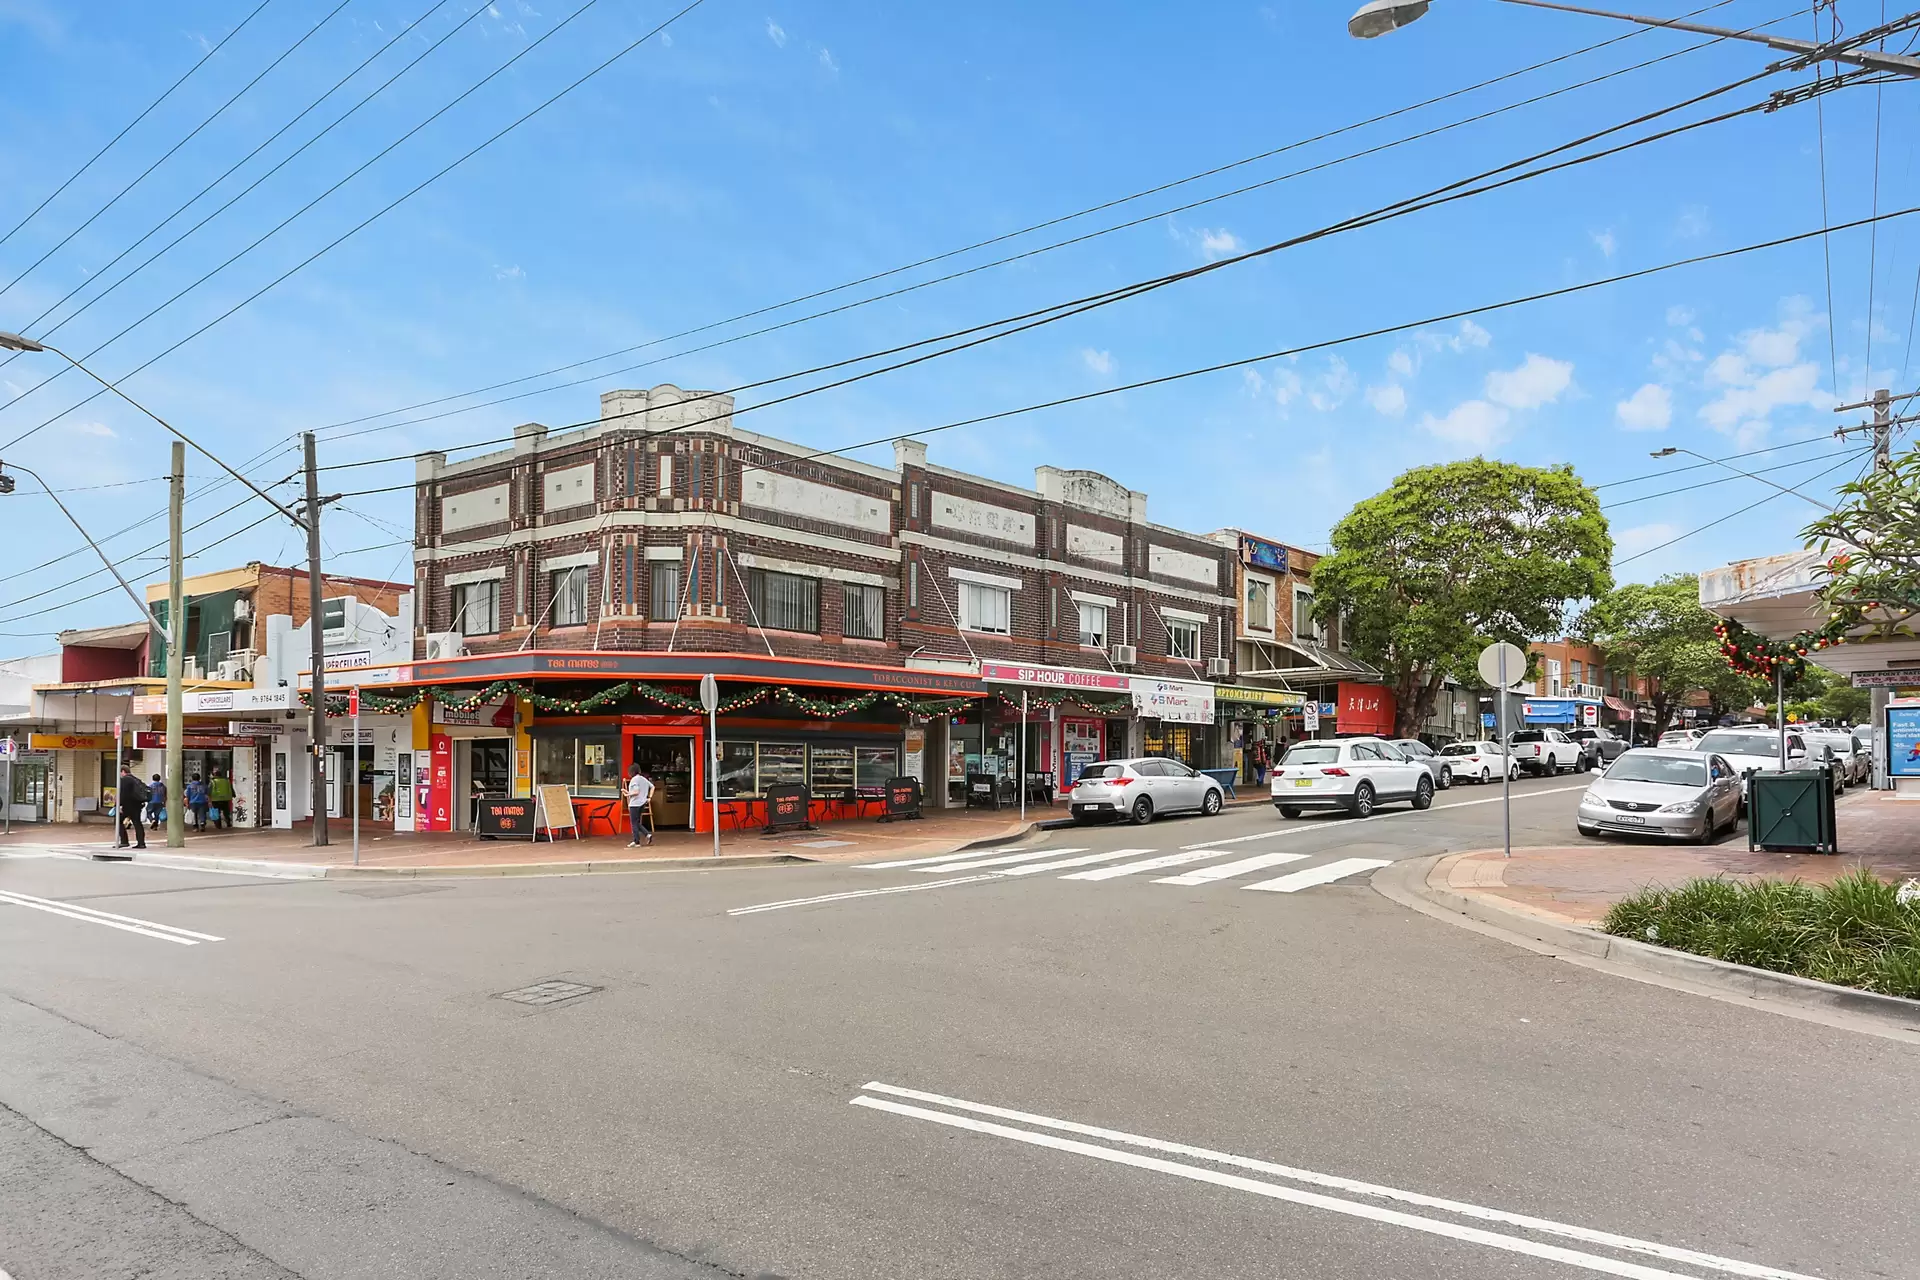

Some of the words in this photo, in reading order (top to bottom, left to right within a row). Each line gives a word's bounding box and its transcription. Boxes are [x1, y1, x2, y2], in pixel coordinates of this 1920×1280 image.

[872, 674, 932, 686] TOBACCONIST
[943, 680, 958, 688] KEY
[960, 680, 977, 689] CUT
[1018, 669, 1034, 681] SIP
[1036, 670, 1064, 684] HOUR
[1068, 673, 1101, 687] COFFEE
